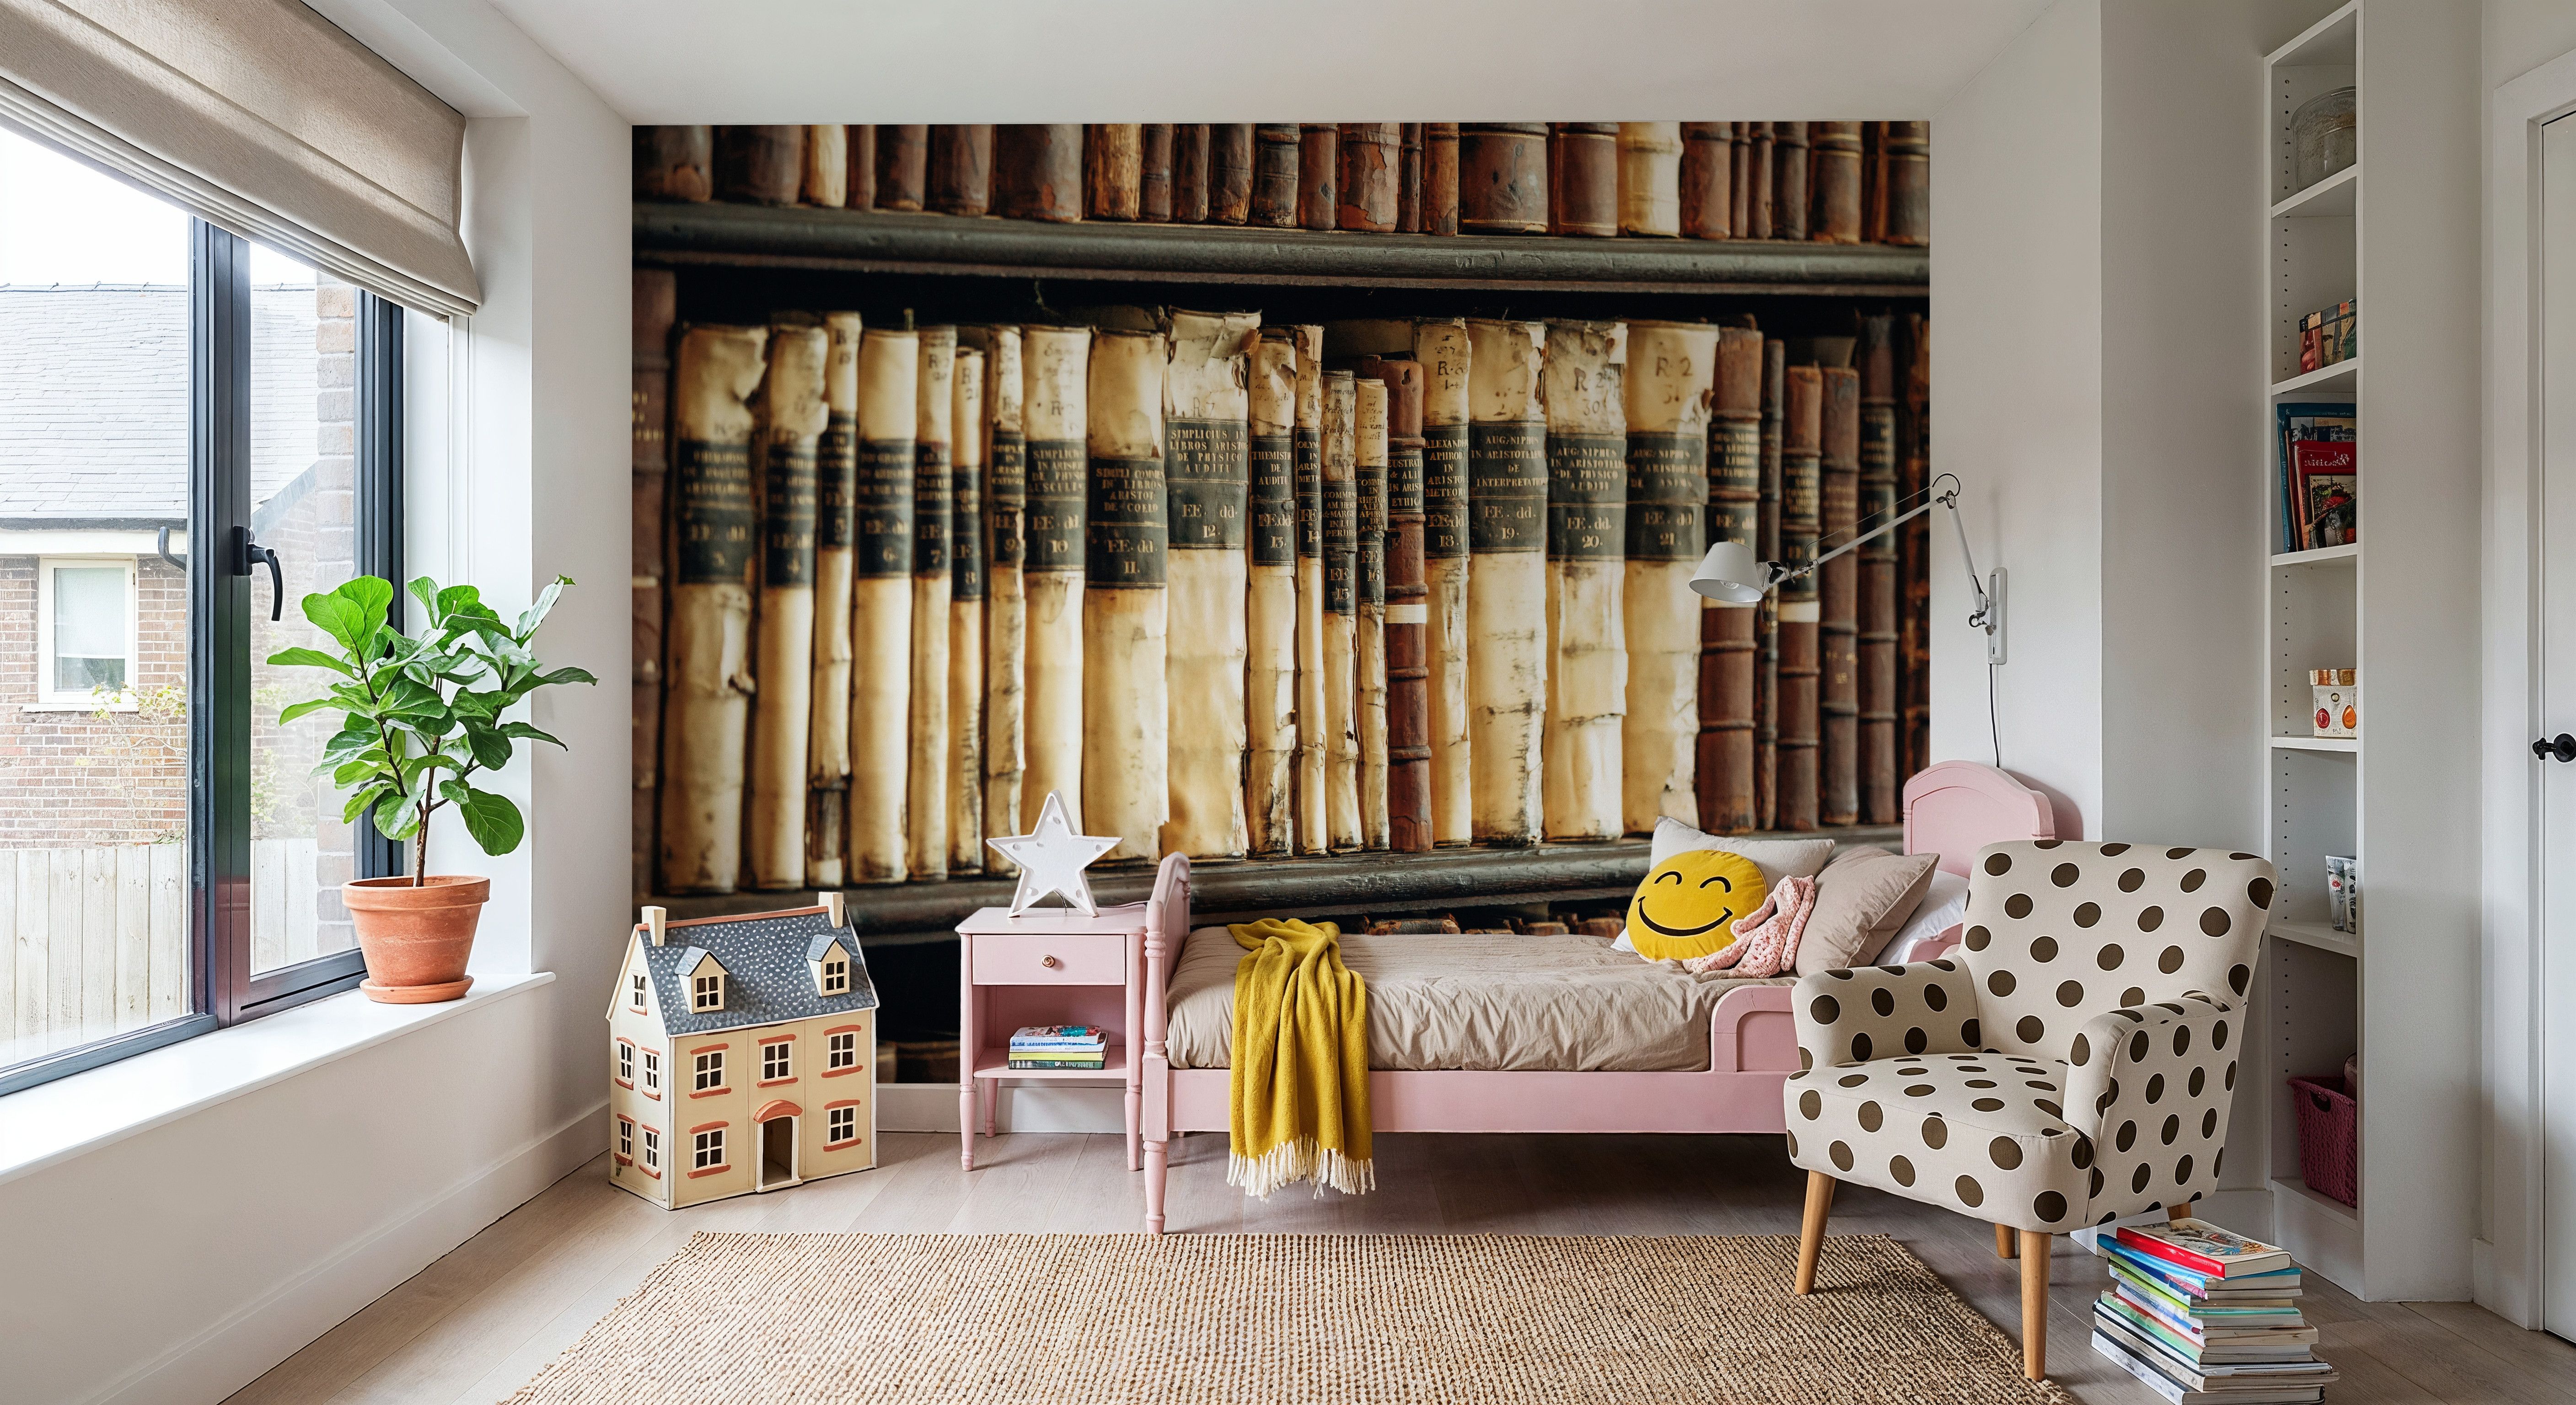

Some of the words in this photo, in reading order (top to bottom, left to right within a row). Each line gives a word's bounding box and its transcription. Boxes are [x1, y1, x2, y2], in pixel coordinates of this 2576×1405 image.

[1656, 357, 1670, 377] R
[1680, 356, 1693, 377] 2
[1171, 429, 1228, 439] SIMPLICIUS
[1236, 430, 1245, 440] IN
[1170, 440, 1207, 450] LIBROS
[1178, 453, 1189, 461] DE
[1198, 452, 1243, 462] PHYSICO
[1471, 450, 1482, 458] IN
[1185, 464, 1233, 473] AUDITU
[1271, 463, 1281, 472] DE
[1444, 464, 1453, 472] IN
[1258, 476, 1289, 485] AUDITU
[1389, 483, 1399, 492] IN
[1368, 569, 1380, 581] 16
